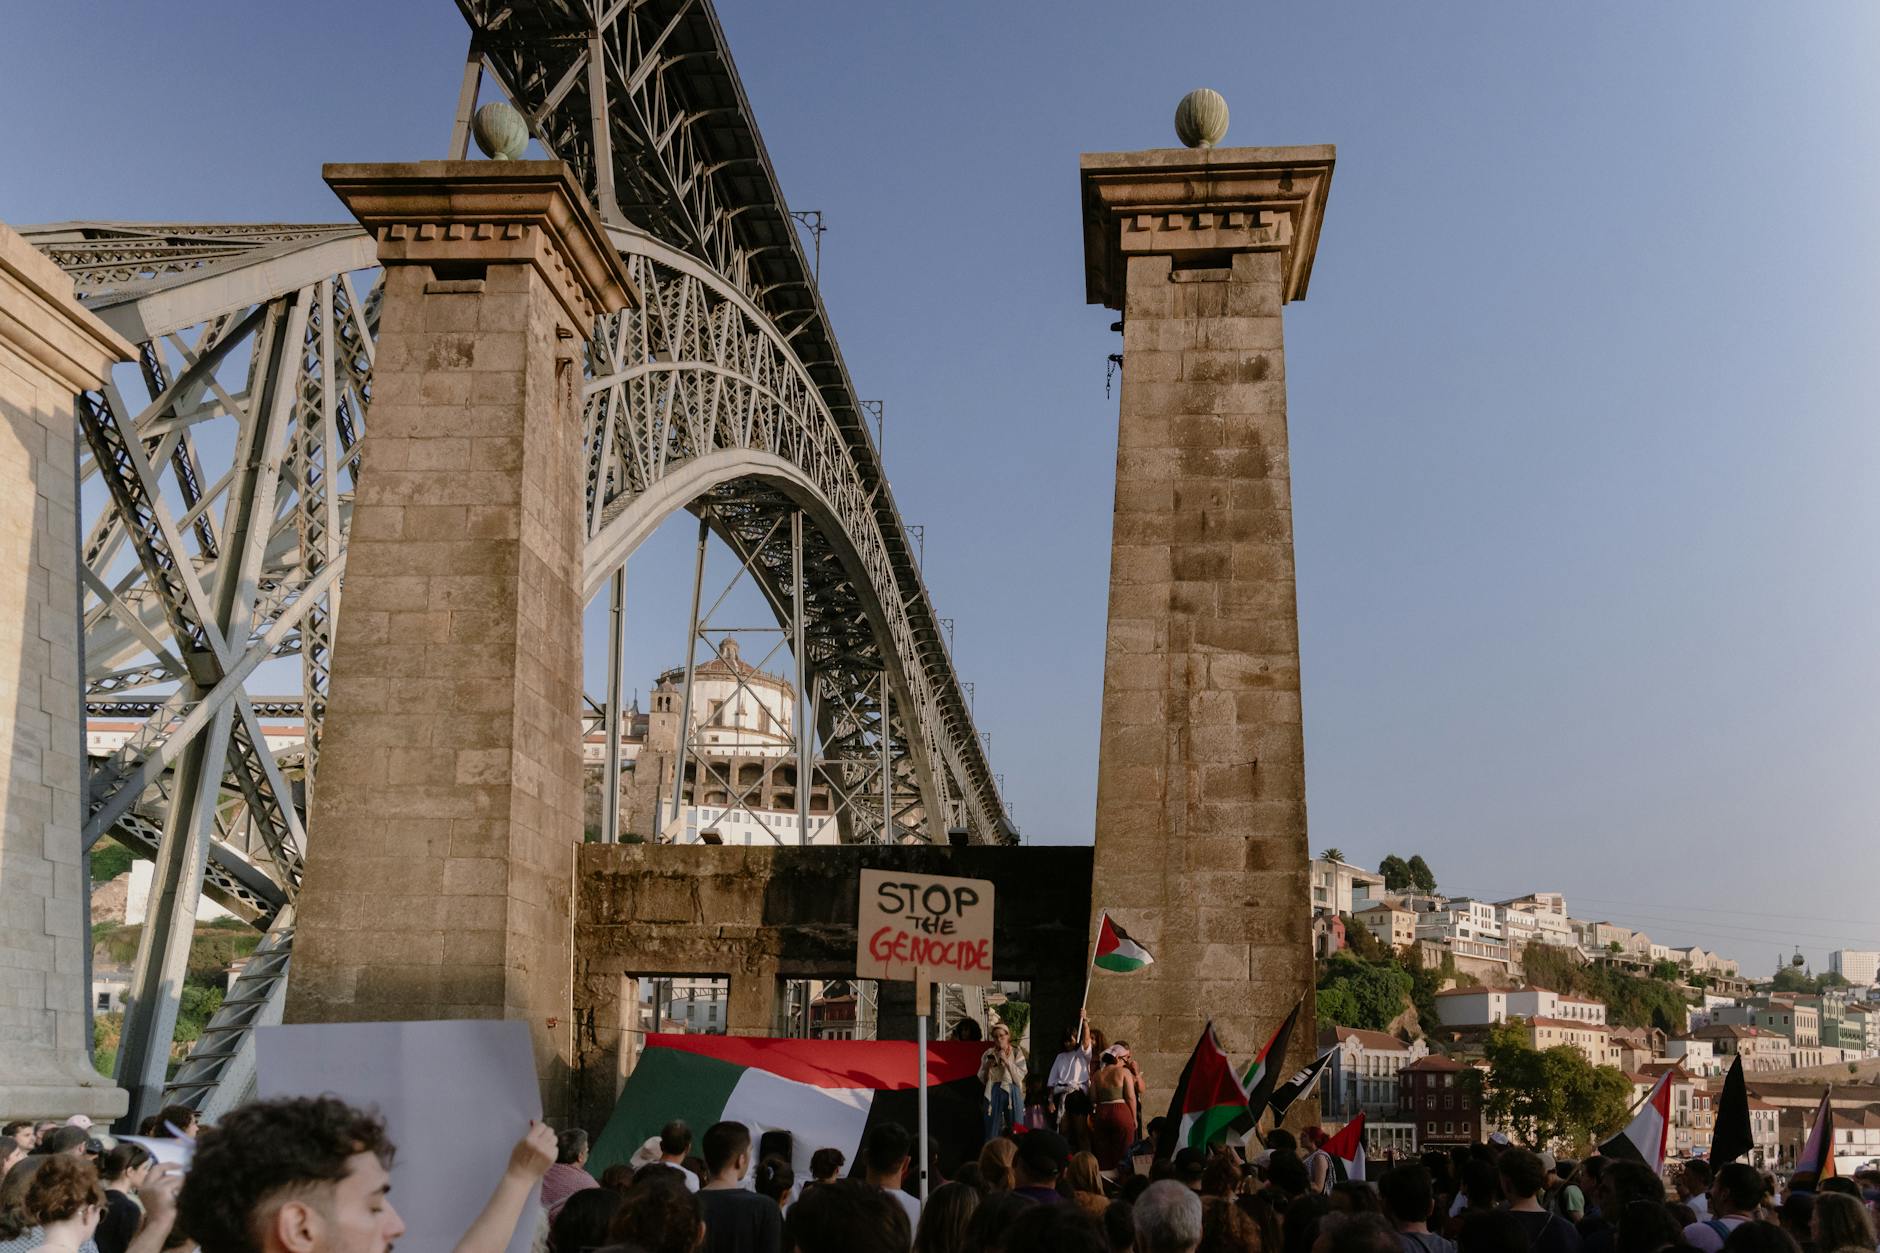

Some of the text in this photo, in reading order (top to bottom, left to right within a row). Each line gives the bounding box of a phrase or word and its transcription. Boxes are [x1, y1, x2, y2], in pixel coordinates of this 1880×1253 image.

[877, 881, 979, 917] STOP
[906, 915, 957, 935] THE
[869, 926, 991, 971] GENOCIDE
